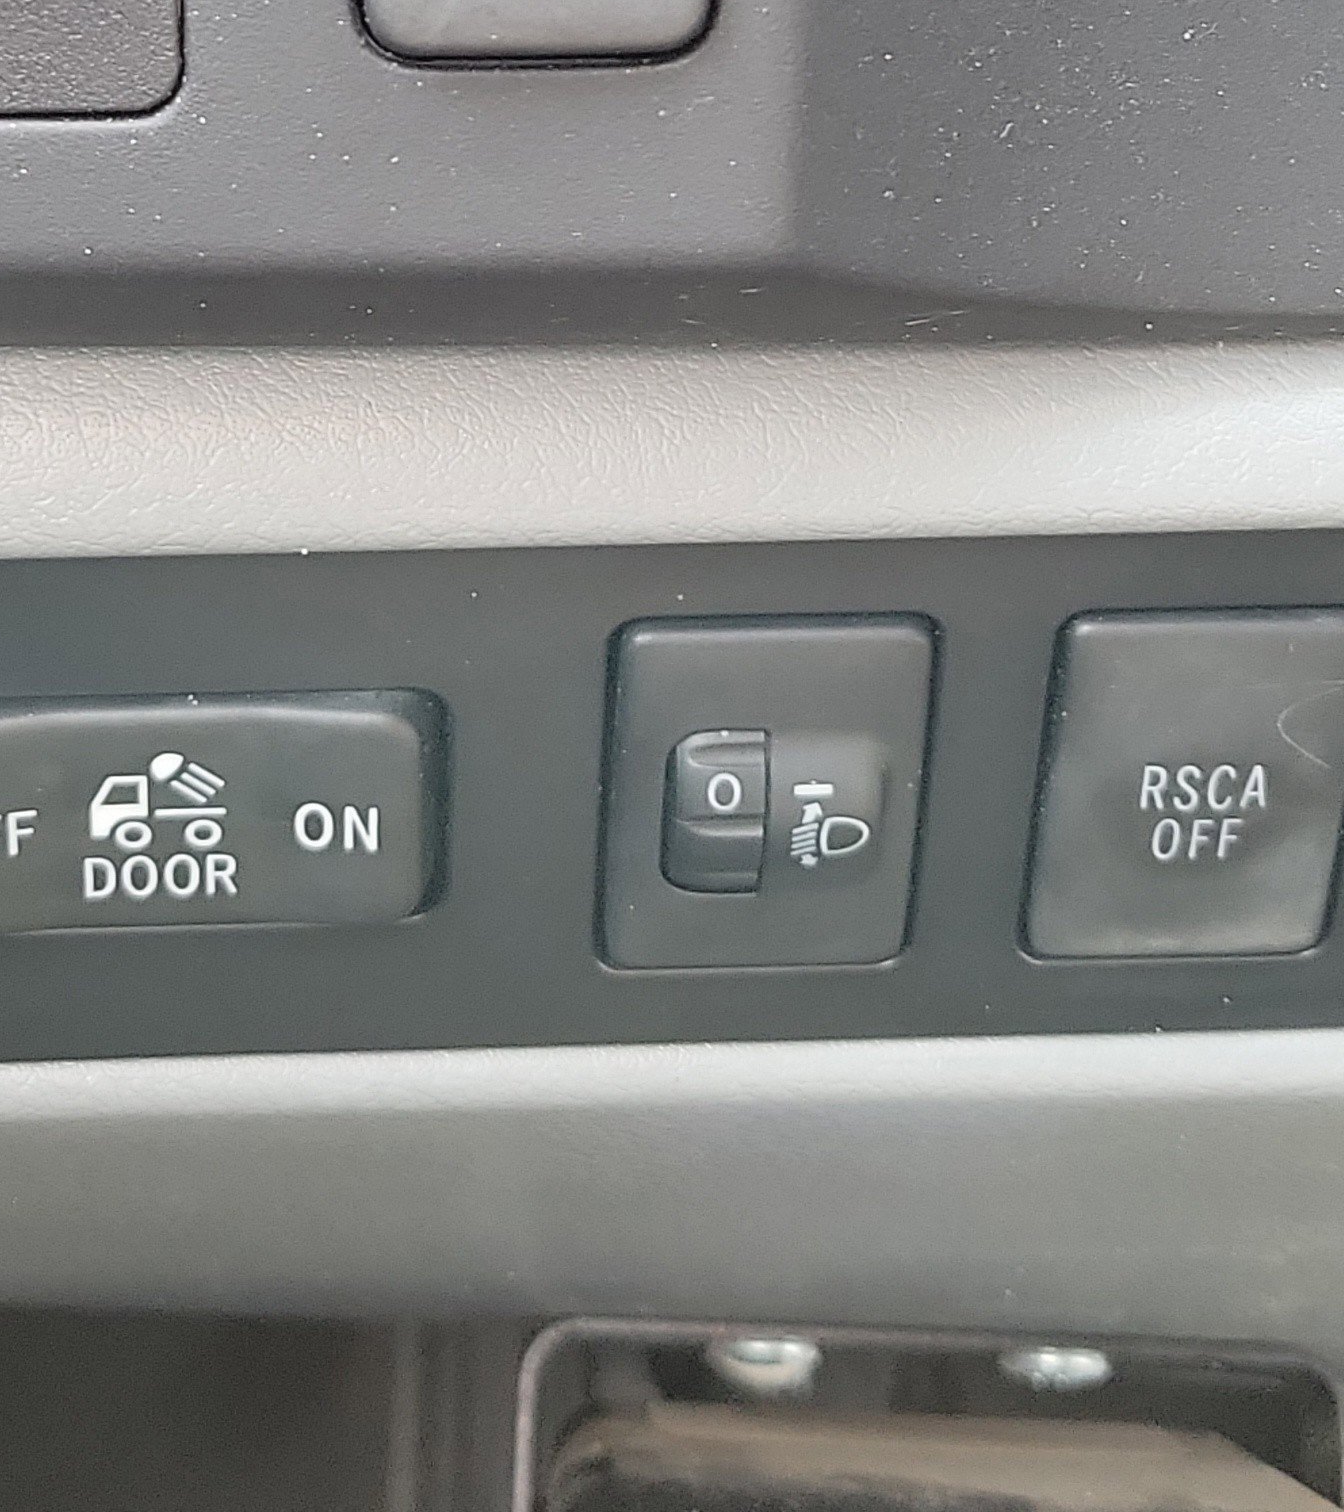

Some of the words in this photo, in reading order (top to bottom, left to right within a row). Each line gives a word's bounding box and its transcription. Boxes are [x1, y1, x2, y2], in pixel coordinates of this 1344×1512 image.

[1139, 764, 1268, 812] RSCA
[294, 802, 380, 853] ON
[1151, 818, 1245, 861] OFF
[83, 853, 238, 899] DOOR
